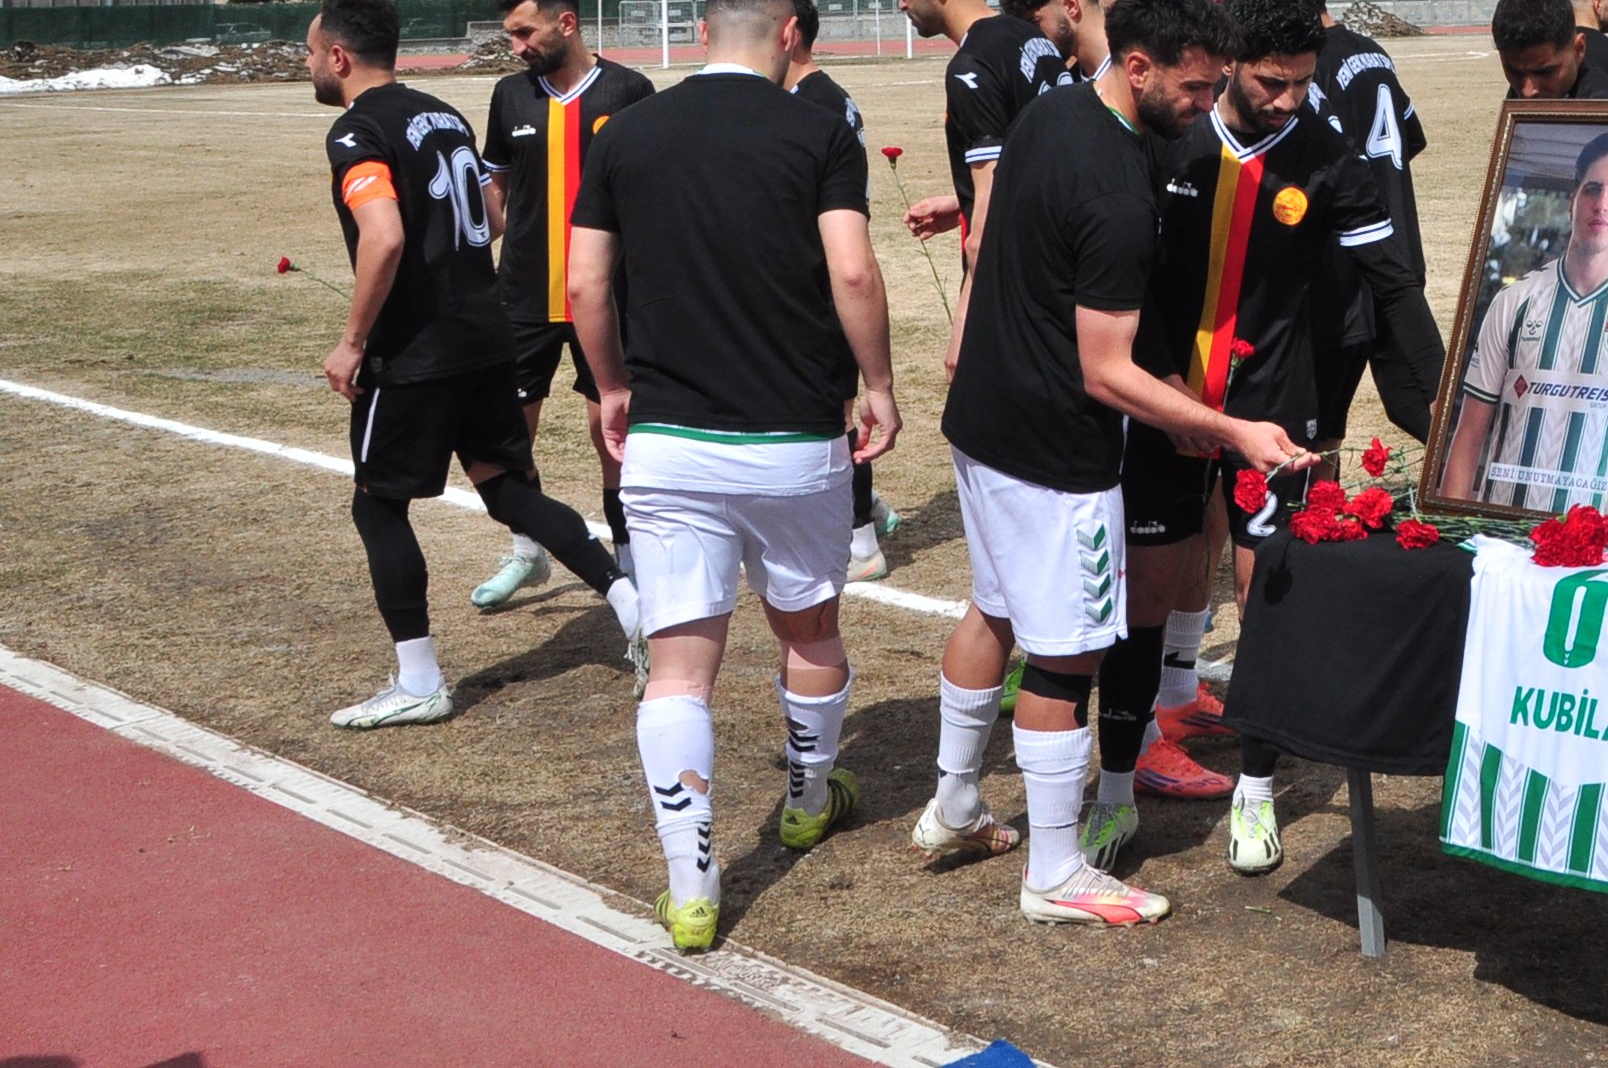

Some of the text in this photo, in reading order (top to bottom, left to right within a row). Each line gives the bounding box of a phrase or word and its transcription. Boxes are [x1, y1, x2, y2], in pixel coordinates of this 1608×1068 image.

[1366, 83, 1403, 170] 4
[428, 145, 491, 251] 10
[1490, 466, 1608, 491] SENİ UNUTMAYACAĞIZ
